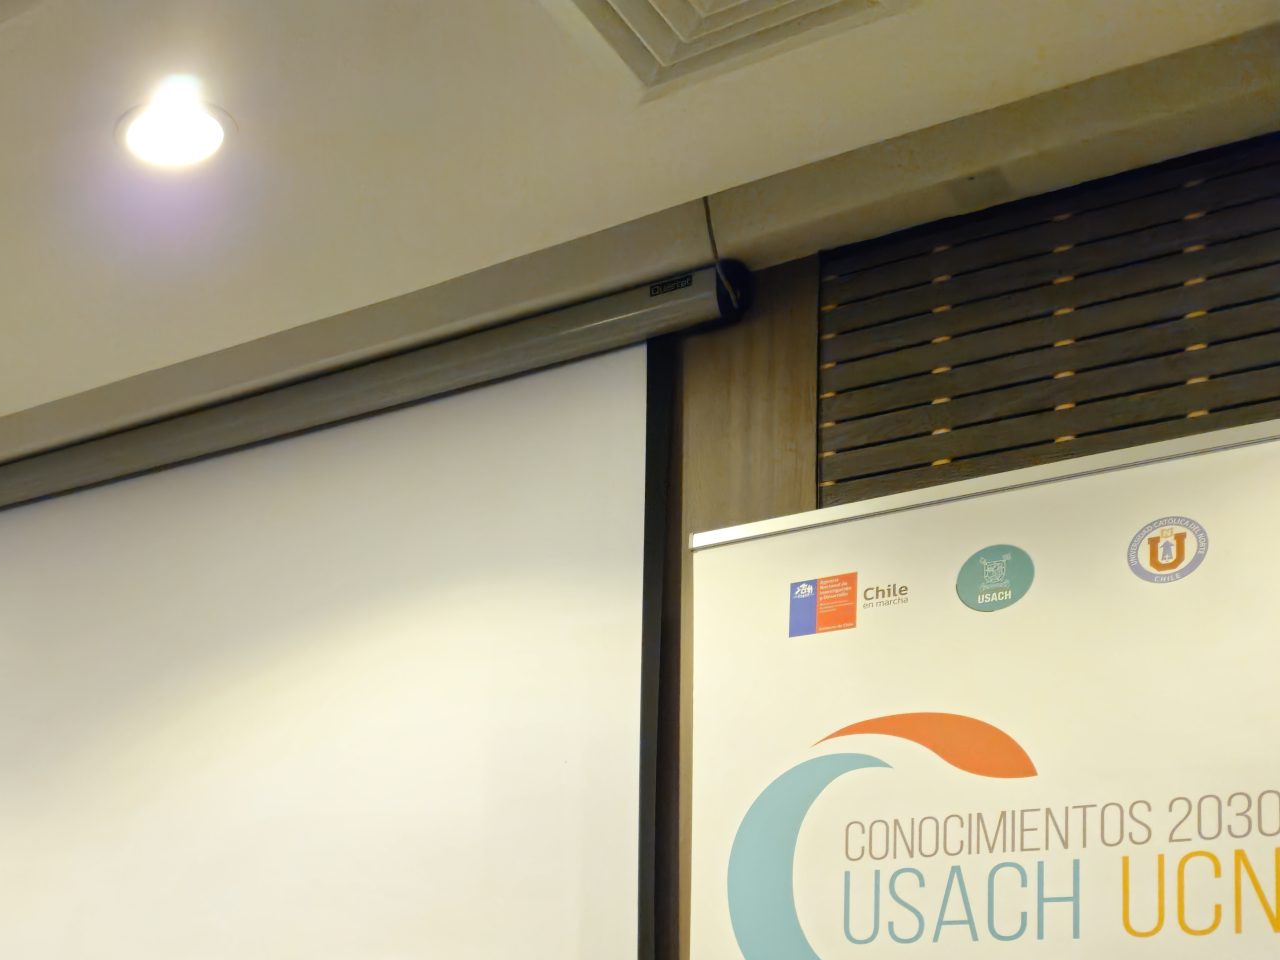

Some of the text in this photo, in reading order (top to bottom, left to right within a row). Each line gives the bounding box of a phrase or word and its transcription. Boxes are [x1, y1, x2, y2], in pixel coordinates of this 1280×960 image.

[1154, 572, 1181, 583] CHILE
[863, 583, 909, 601] Chile
[977, 590, 1012, 604] USACH
[876, 596, 909, 608] marcha
[845, 789, 1280, 861] CONOCIMIENTOS 2030
[844, 846, 1280, 945] USACH UCN
